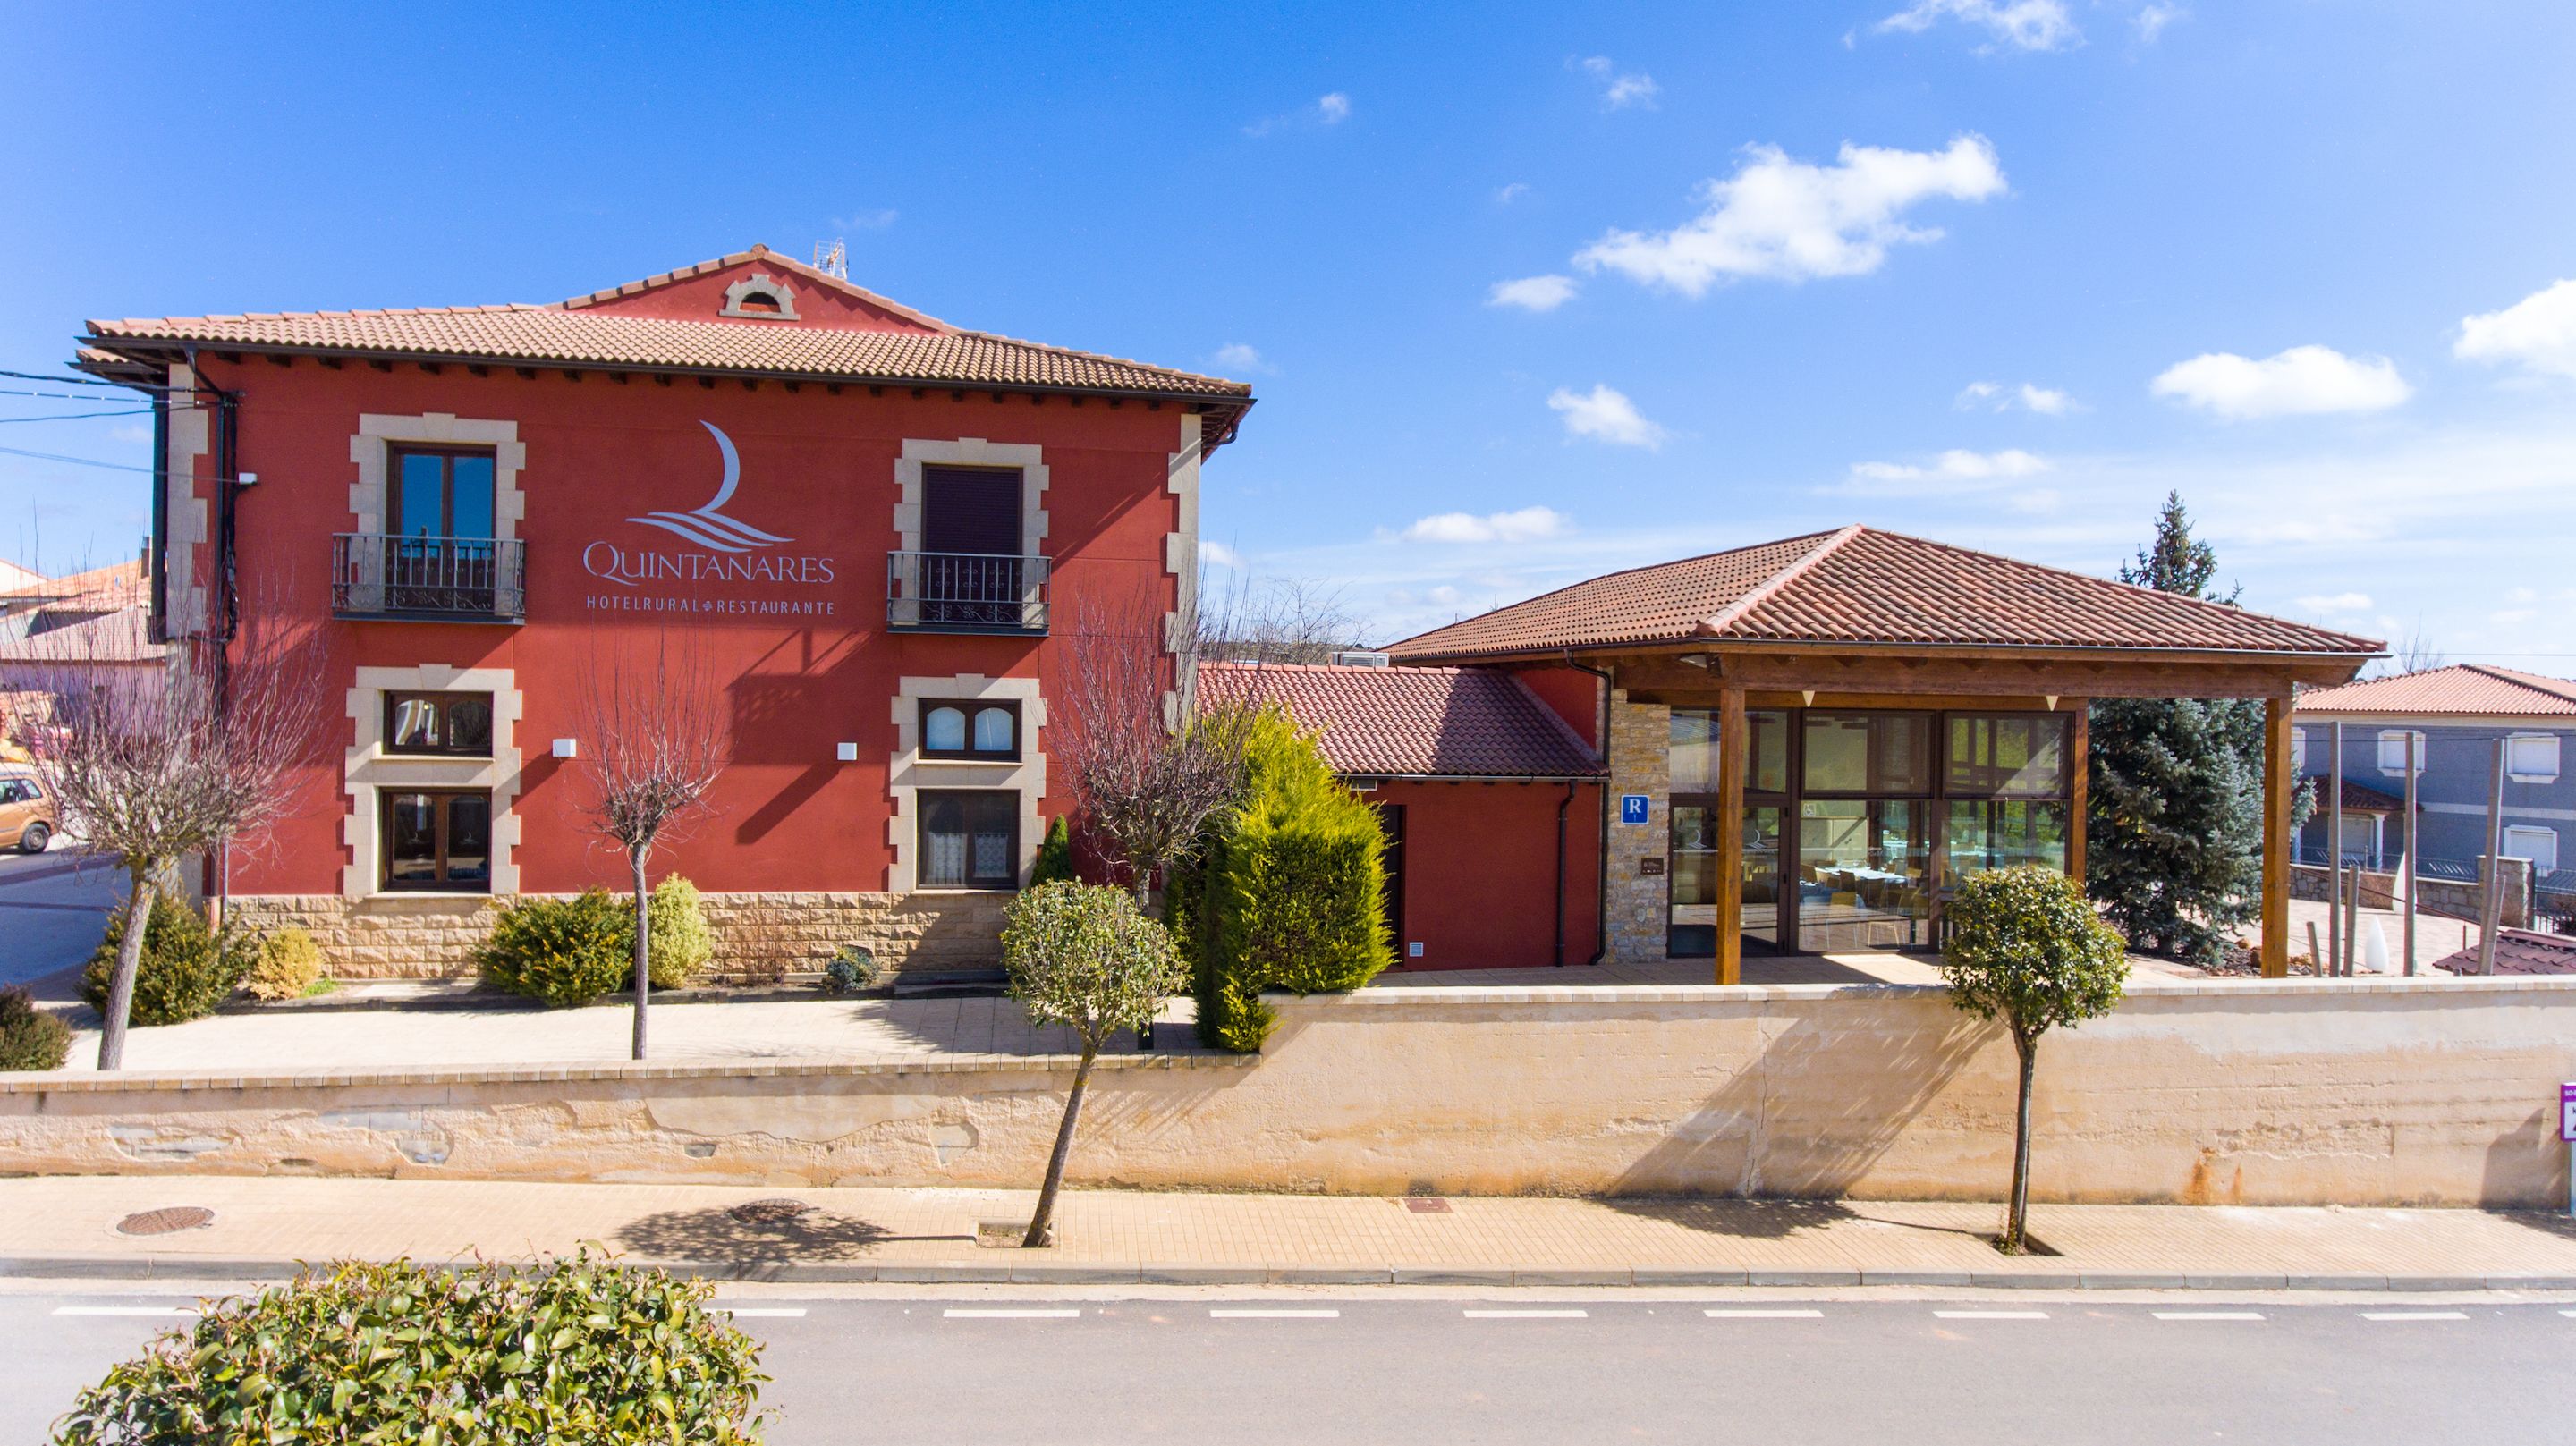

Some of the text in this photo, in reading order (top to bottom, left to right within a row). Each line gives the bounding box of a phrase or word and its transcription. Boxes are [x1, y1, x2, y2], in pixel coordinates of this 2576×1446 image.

[582, 540, 835, 586] QUINTANARES
[716, 600, 834, 615] RESTAURANTE
[1629, 799, 1641, 814] R
